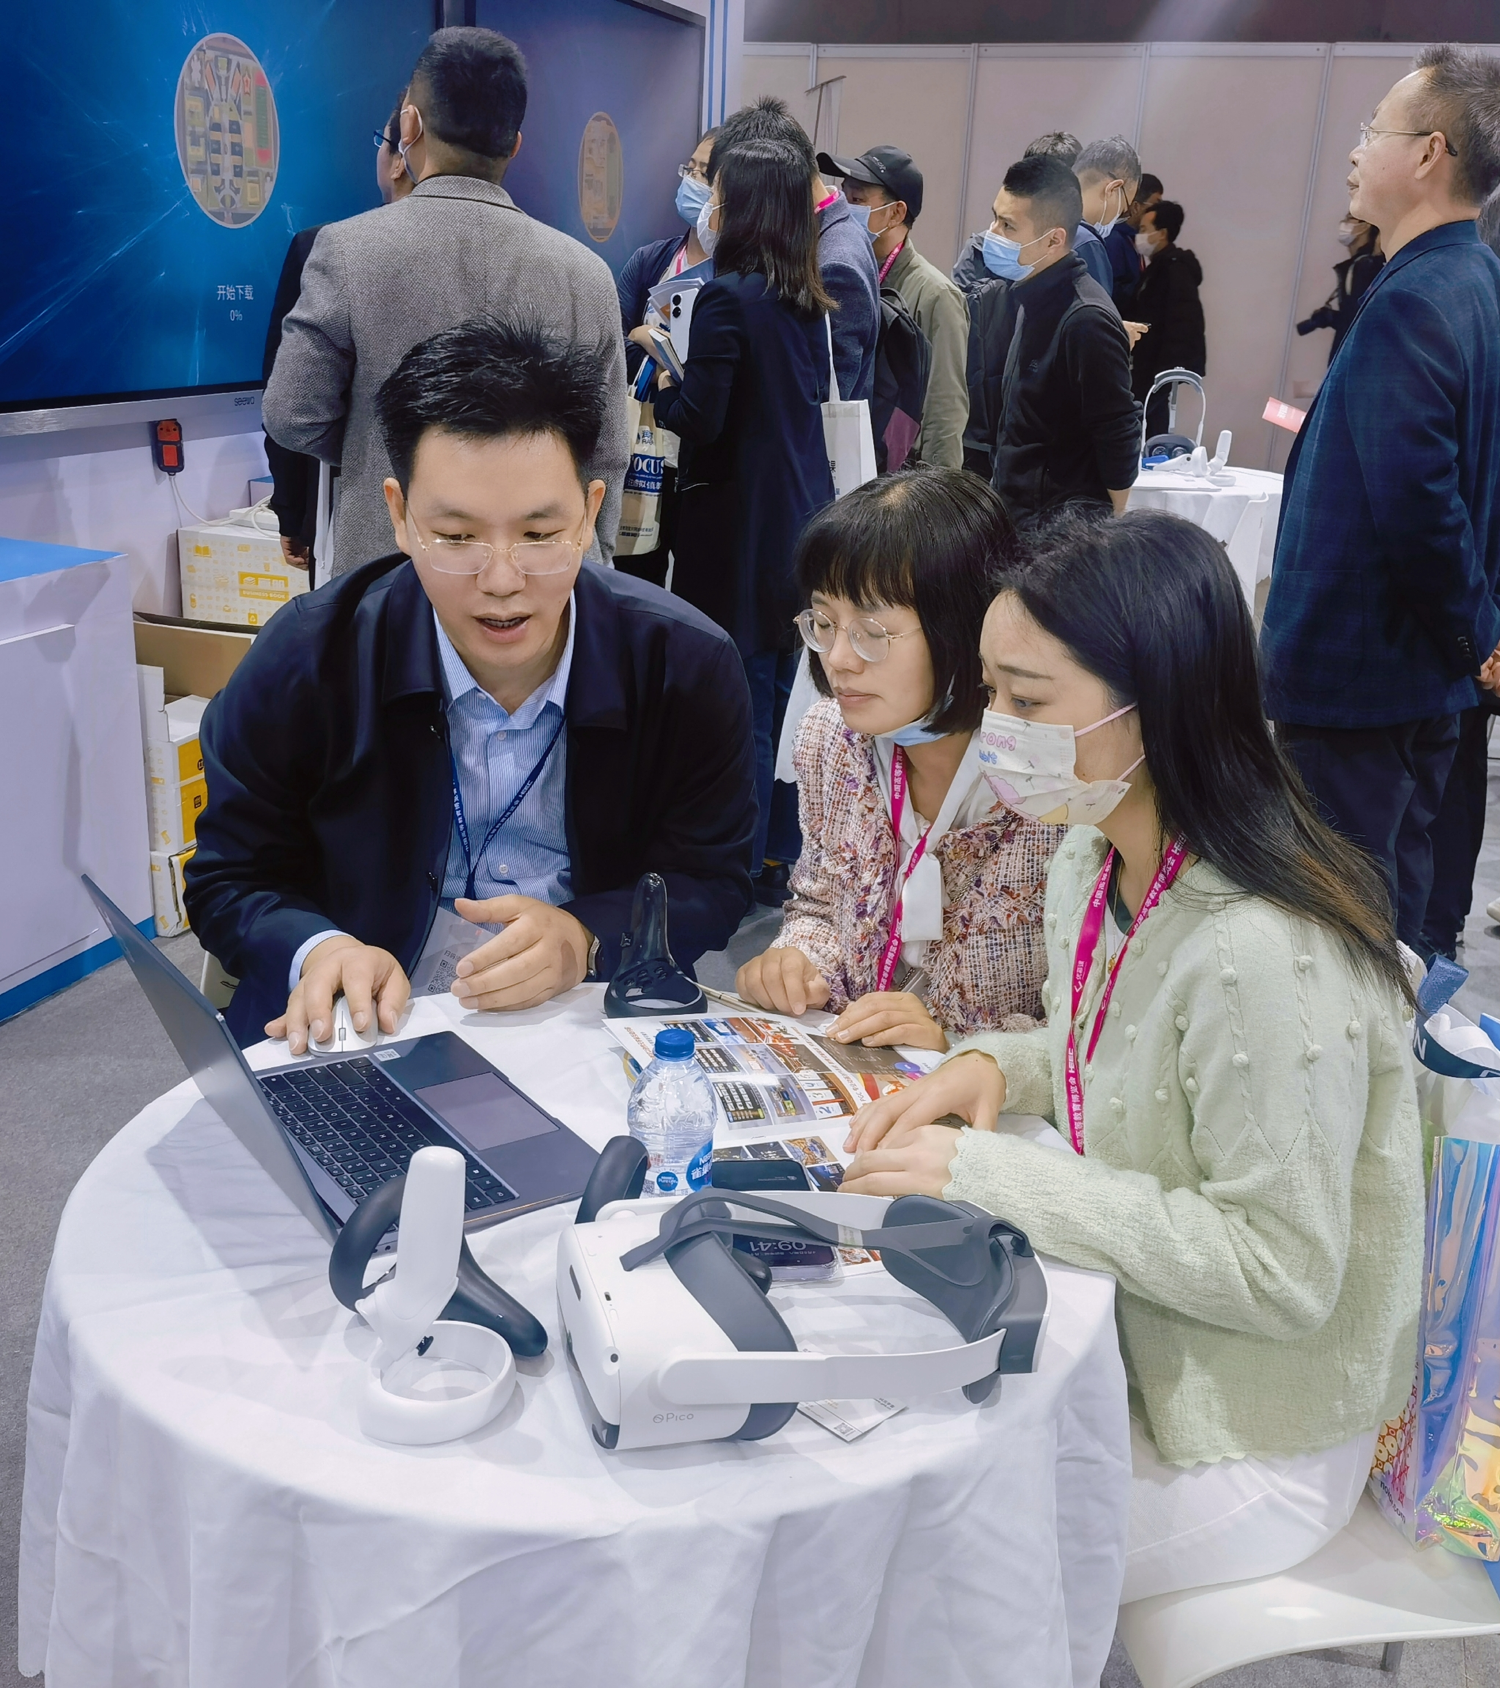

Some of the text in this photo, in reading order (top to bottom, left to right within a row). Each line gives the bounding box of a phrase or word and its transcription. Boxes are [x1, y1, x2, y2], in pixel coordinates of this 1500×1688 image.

[217, 284, 254, 301] 开始下载
[230, 309, 243, 321] 0%
[750, 1240, 807, 1253] 09:41
